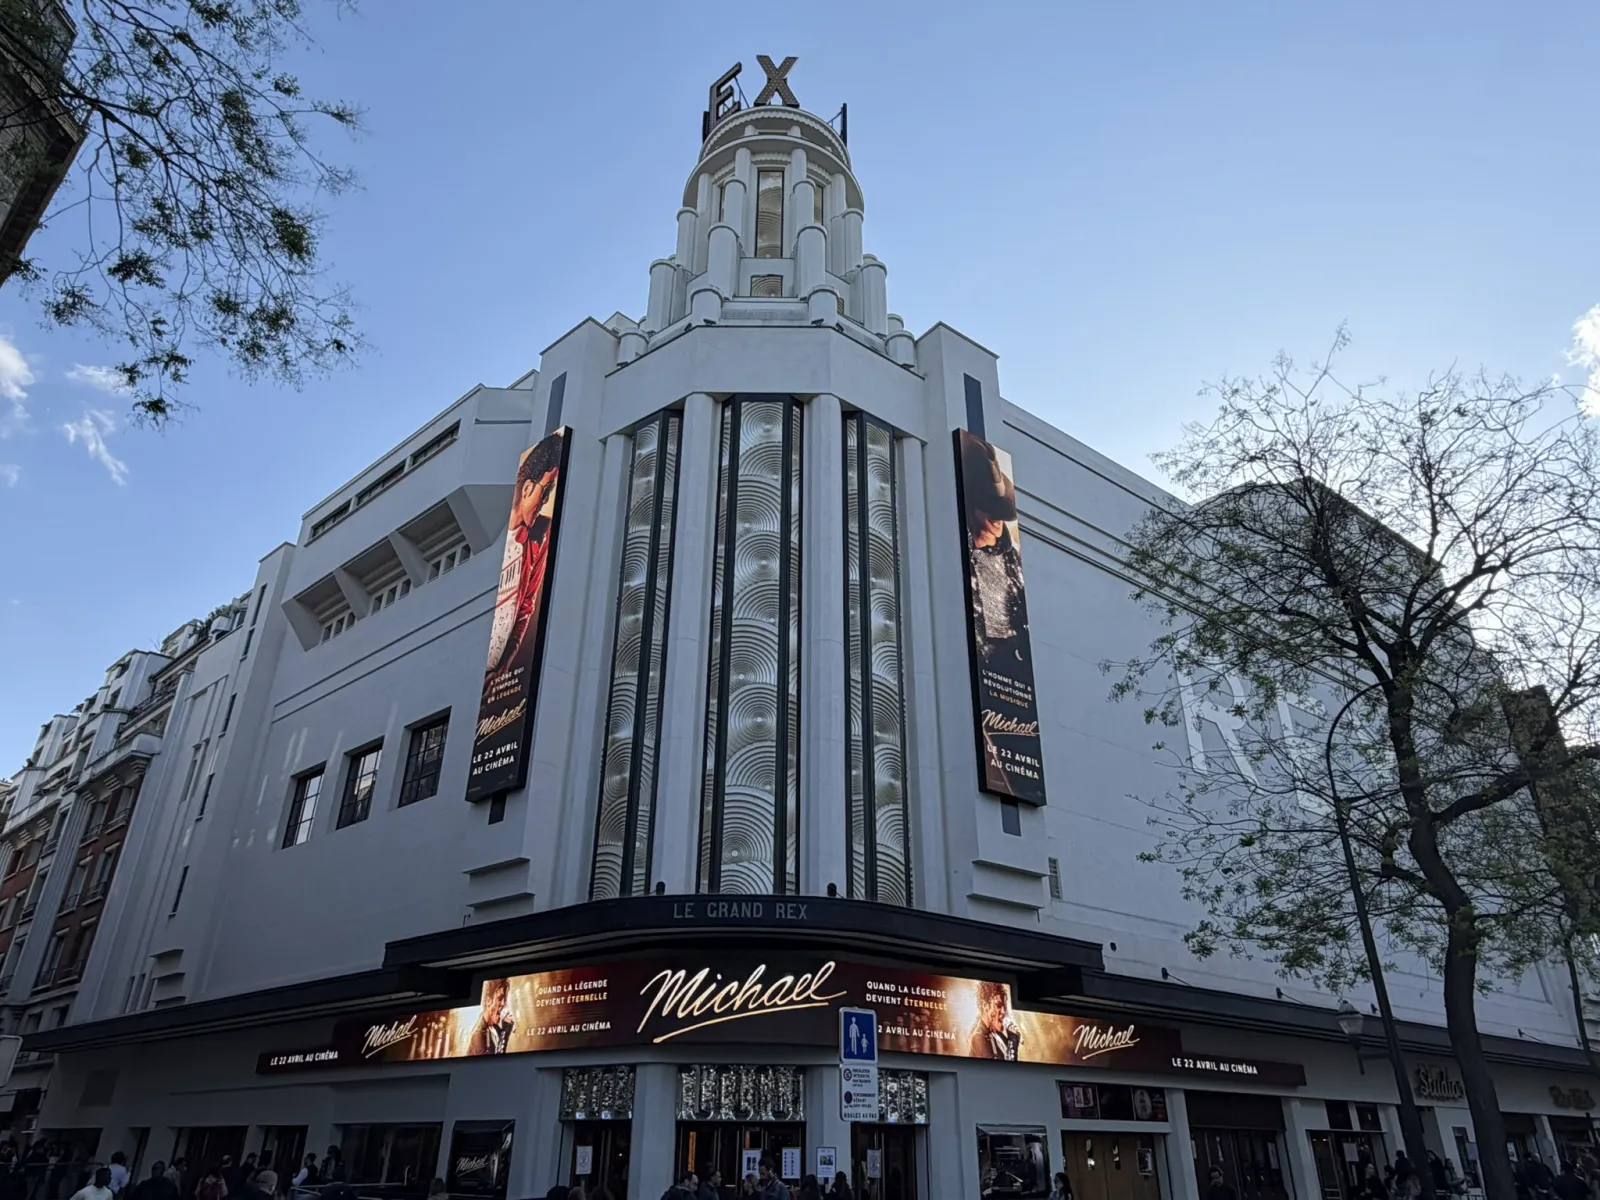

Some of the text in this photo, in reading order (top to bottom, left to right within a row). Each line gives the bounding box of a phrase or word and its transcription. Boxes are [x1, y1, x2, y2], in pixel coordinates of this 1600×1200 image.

[982, 669, 1012, 685] L'HOMME
[1014, 681, 1026, 689] QUI
[983, 678, 1032, 701] RÉVOLUTIONNÉ
[1000, 693, 1028, 709] MUSIQUE
[475, 698, 526, 744] Michael
[981, 709, 1040, 736] Michael
[473, 741, 518, 763] LE 22 AVRIL
[987, 744, 1040, 768] LE 22 AVRIL
[473, 755, 514, 776] AU CINÉMA
[991, 759, 1039, 780] AU CINÉMA
[673, 902, 808, 920] LE GRAND REX
[538, 979, 608, 995] QUAND LA LÉGENDE
[866, 981, 947, 999] QUAND LA LÉGENDE
[536, 992, 608, 1007] DEVIENT ÉTERNELLE
[637, 961, 847, 1043] Michael
[865, 993, 948, 1011] DEVIENT ÉTERNELLE
[361, 1014, 419, 1058] Michael
[526, 1021, 611, 1036] LE 22 AVRIL AU CINÉMA
[885, 1025, 910, 1036] AVRIL
[912, 1029, 923, 1037] AU
[925, 1029, 956, 1041] CINÉMA
[1072, 1024, 1140, 1060] Michael
[270, 1050, 338, 1066] LE 22 AVRIL AU CINÉMA
[1171, 1057, 1258, 1075] LE 22 AVRIL AU CINÉMA
